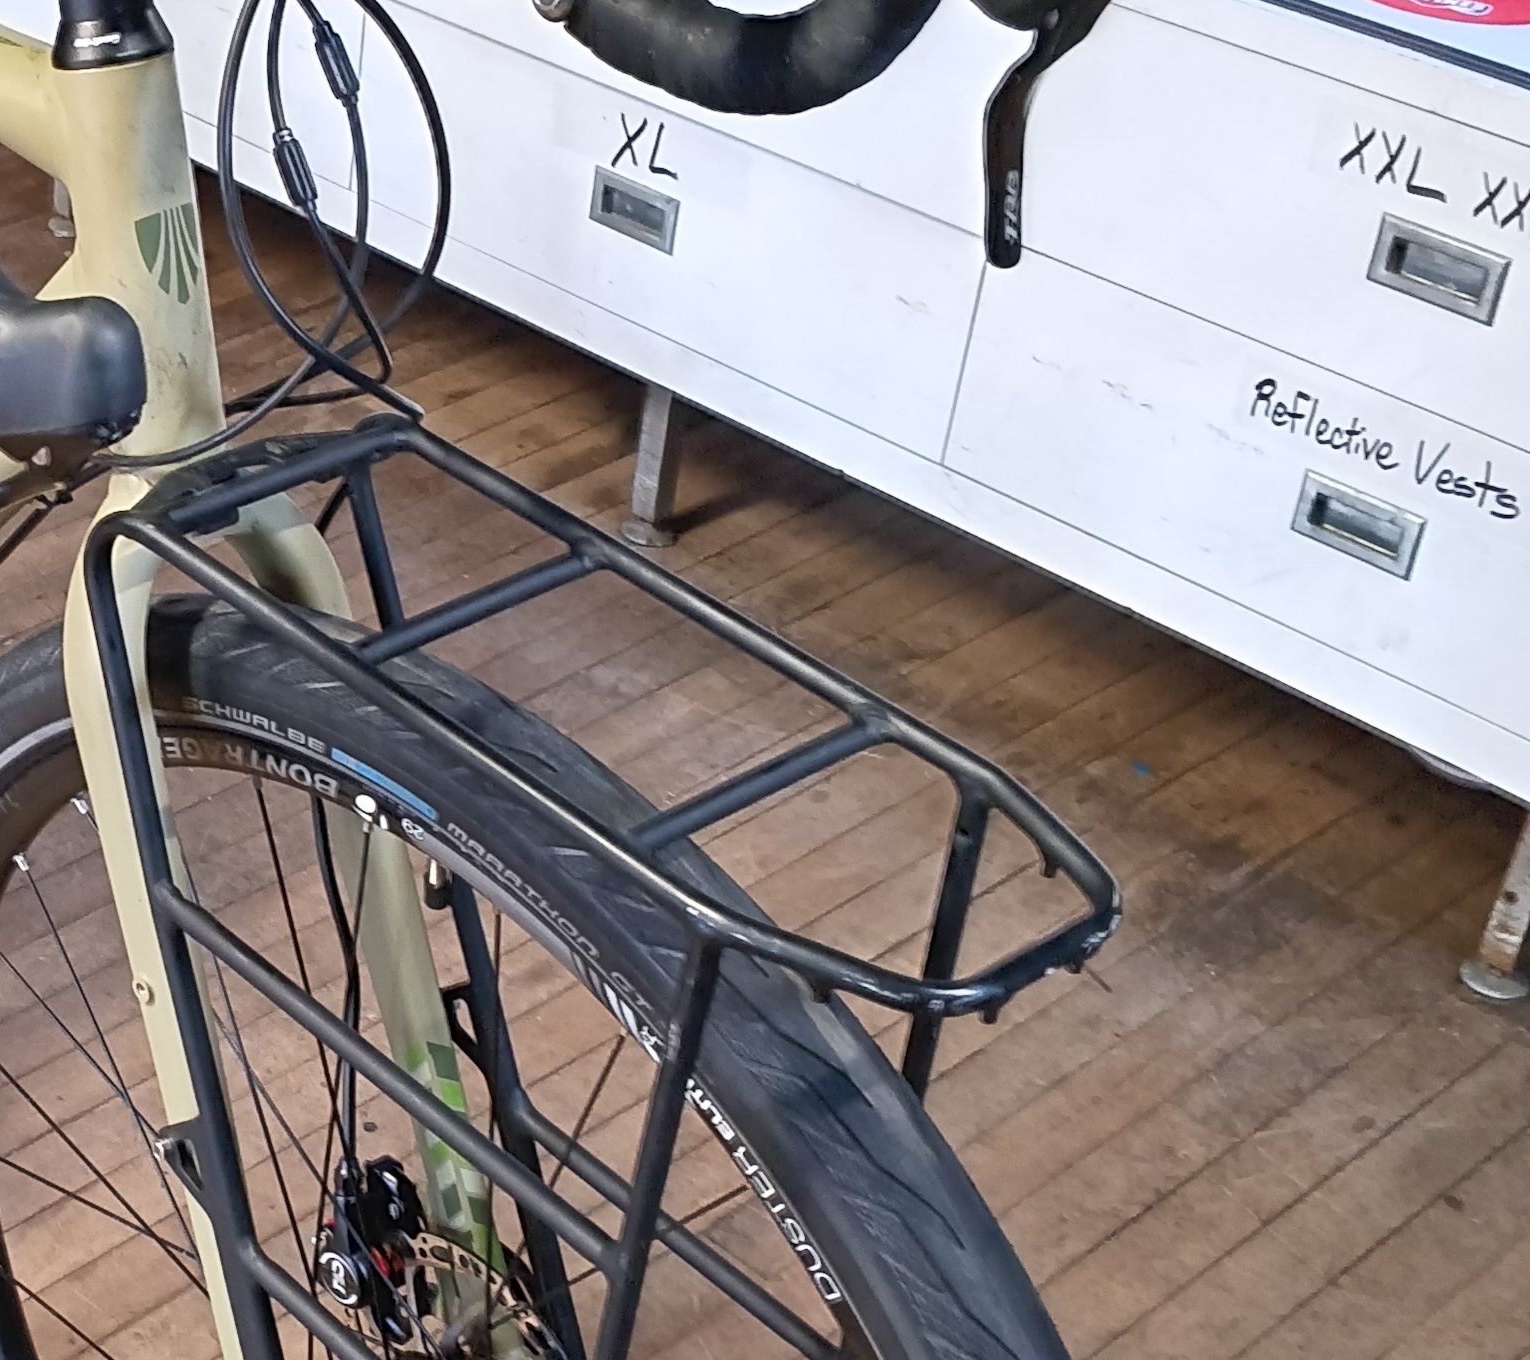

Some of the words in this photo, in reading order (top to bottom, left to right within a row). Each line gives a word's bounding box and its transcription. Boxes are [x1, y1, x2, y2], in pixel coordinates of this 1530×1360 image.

[610, 111, 679, 181] XL
[1338, 120, 1448, 204] XXL
[1413, 439, 1522, 521] Vests
[161, 735, 340, 798] BONTRAGE
[181, 696, 328, 754] SCHWALBE
[446, 821, 601, 959] MARATHON
[732, 1145, 843, 1302] DUSTER
